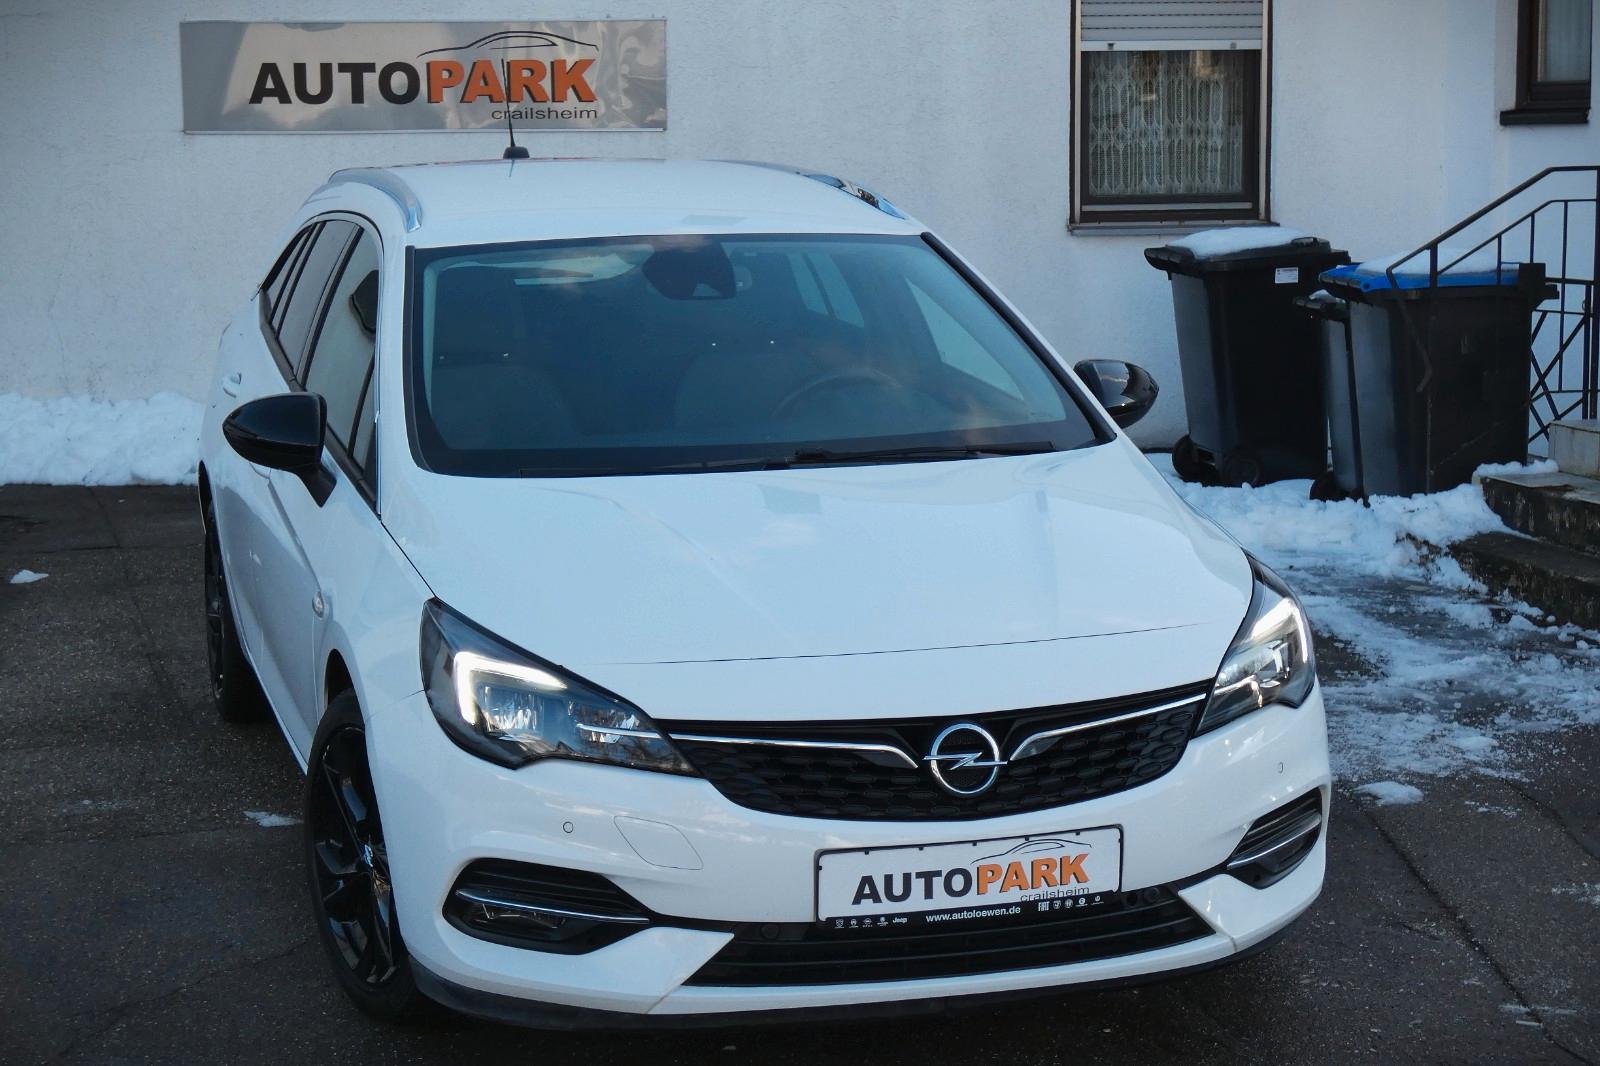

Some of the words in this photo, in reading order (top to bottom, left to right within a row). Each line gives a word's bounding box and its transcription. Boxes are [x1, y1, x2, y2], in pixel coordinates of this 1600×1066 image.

[248, 58, 598, 105] AUTOPARK
[491, 106, 598, 121] crailsheim
[851, 853, 1089, 905] AUTOPARK
[925, 905, 1021, 923] www.autoloewen.de
